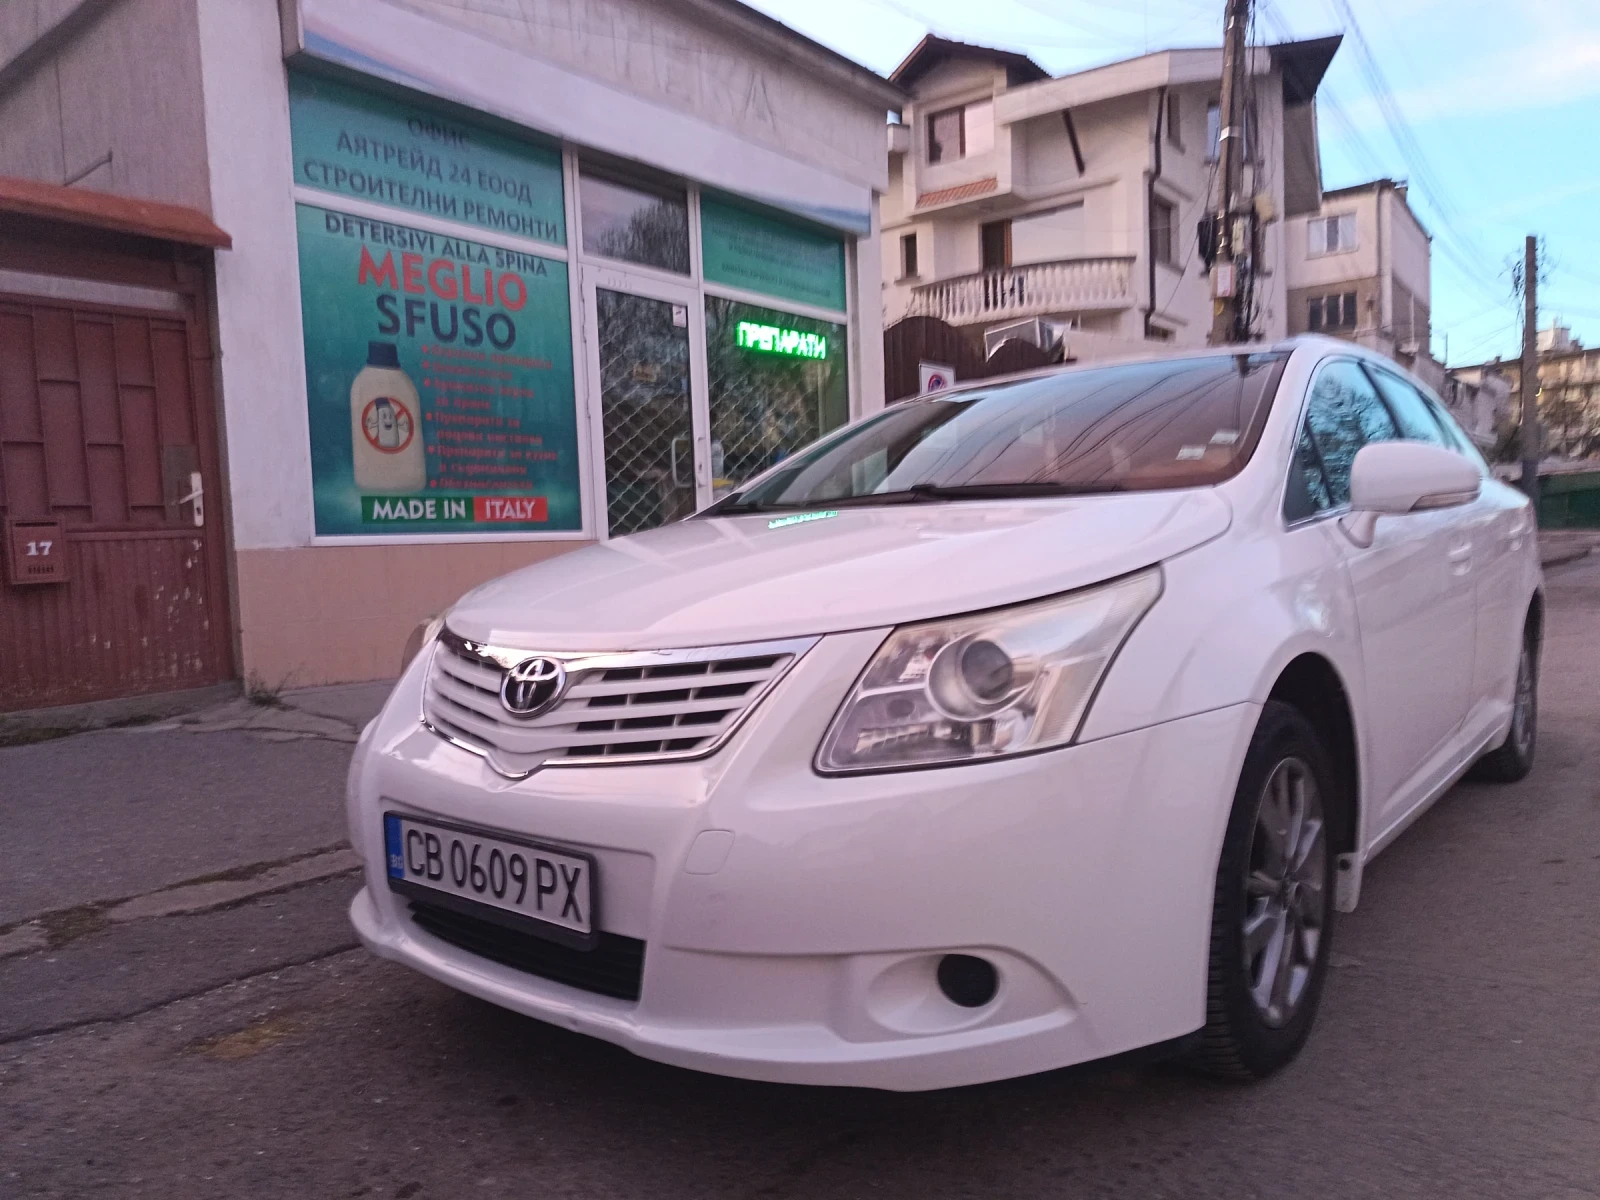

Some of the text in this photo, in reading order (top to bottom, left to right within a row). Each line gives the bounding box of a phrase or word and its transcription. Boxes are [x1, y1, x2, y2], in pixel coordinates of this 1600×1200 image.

[336, 130, 532, 207] АЯТРЕЙД 24 ЕООД
[303, 158, 557, 241] СТРОИТЕЛНИ РЕМОНТИ
[325, 212, 548, 277] DETERSIVI ALLA SPINA
[358, 244, 527, 311] MEGLIO
[376, 293, 516, 351] SFUSO
[737, 321, 826, 360] ПРЕПАРАТИ
[372, 499, 537, 520] MADE IN ITALY
[26, 541, 52, 556] 17
